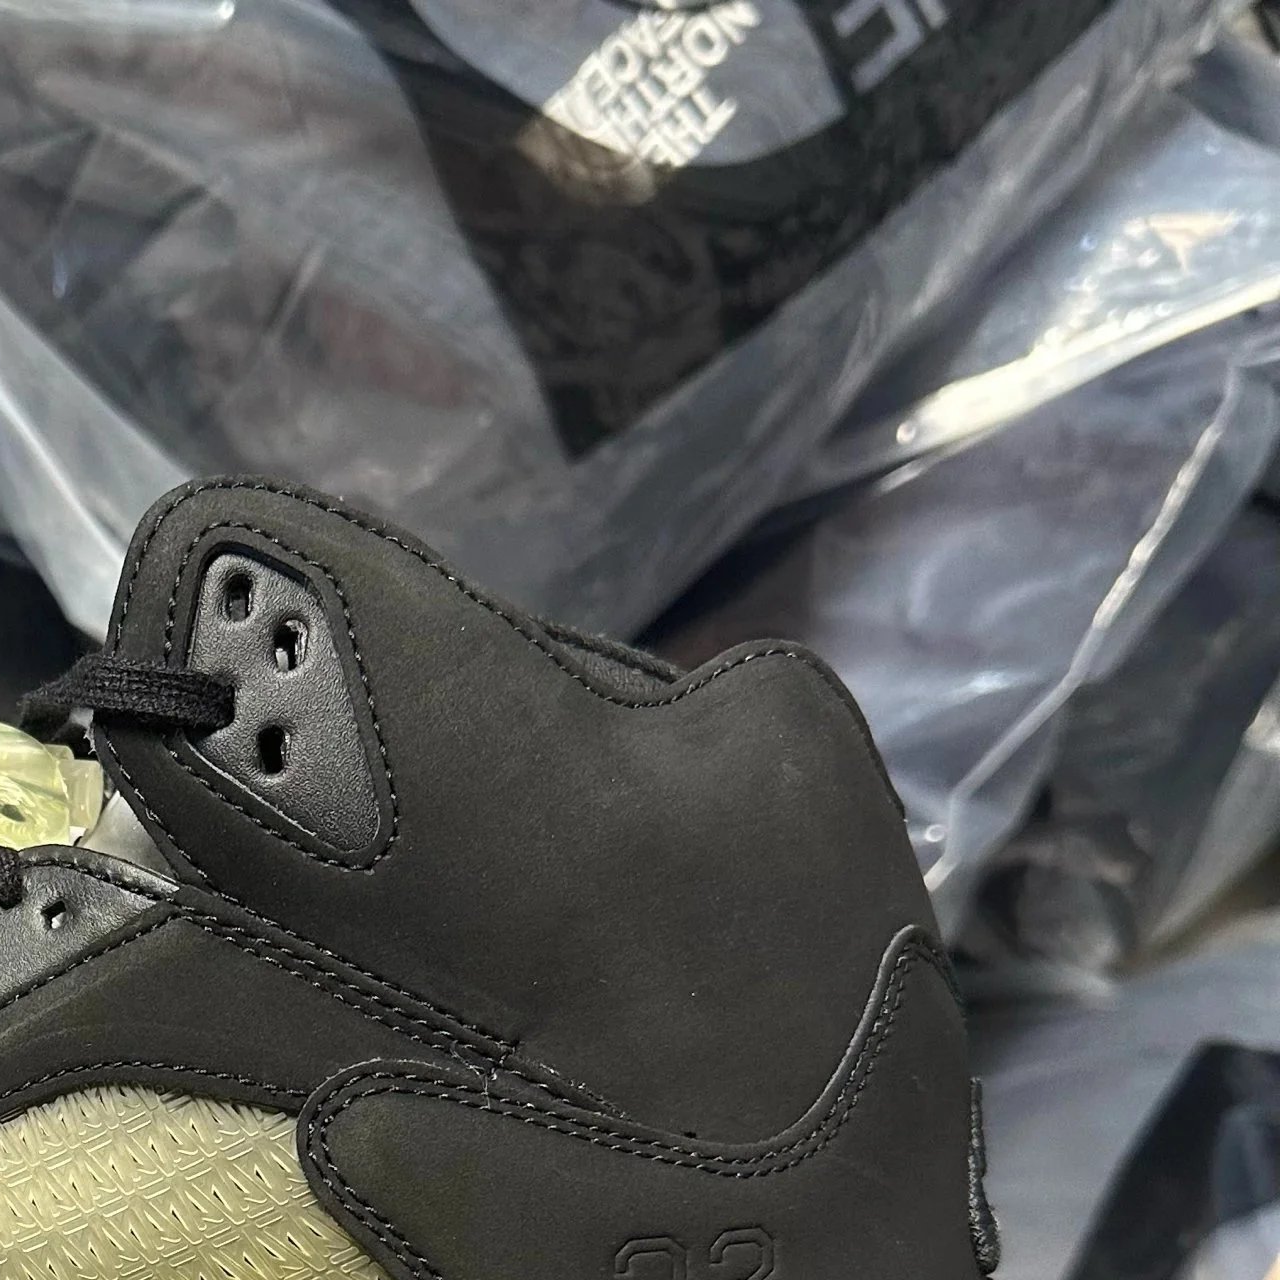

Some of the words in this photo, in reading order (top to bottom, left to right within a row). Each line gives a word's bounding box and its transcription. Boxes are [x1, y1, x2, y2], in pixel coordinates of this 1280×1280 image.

[575, 10, 686, 108] FACE
[604, 3, 762, 142] NORTH
[640, 88, 737, 169] THE
